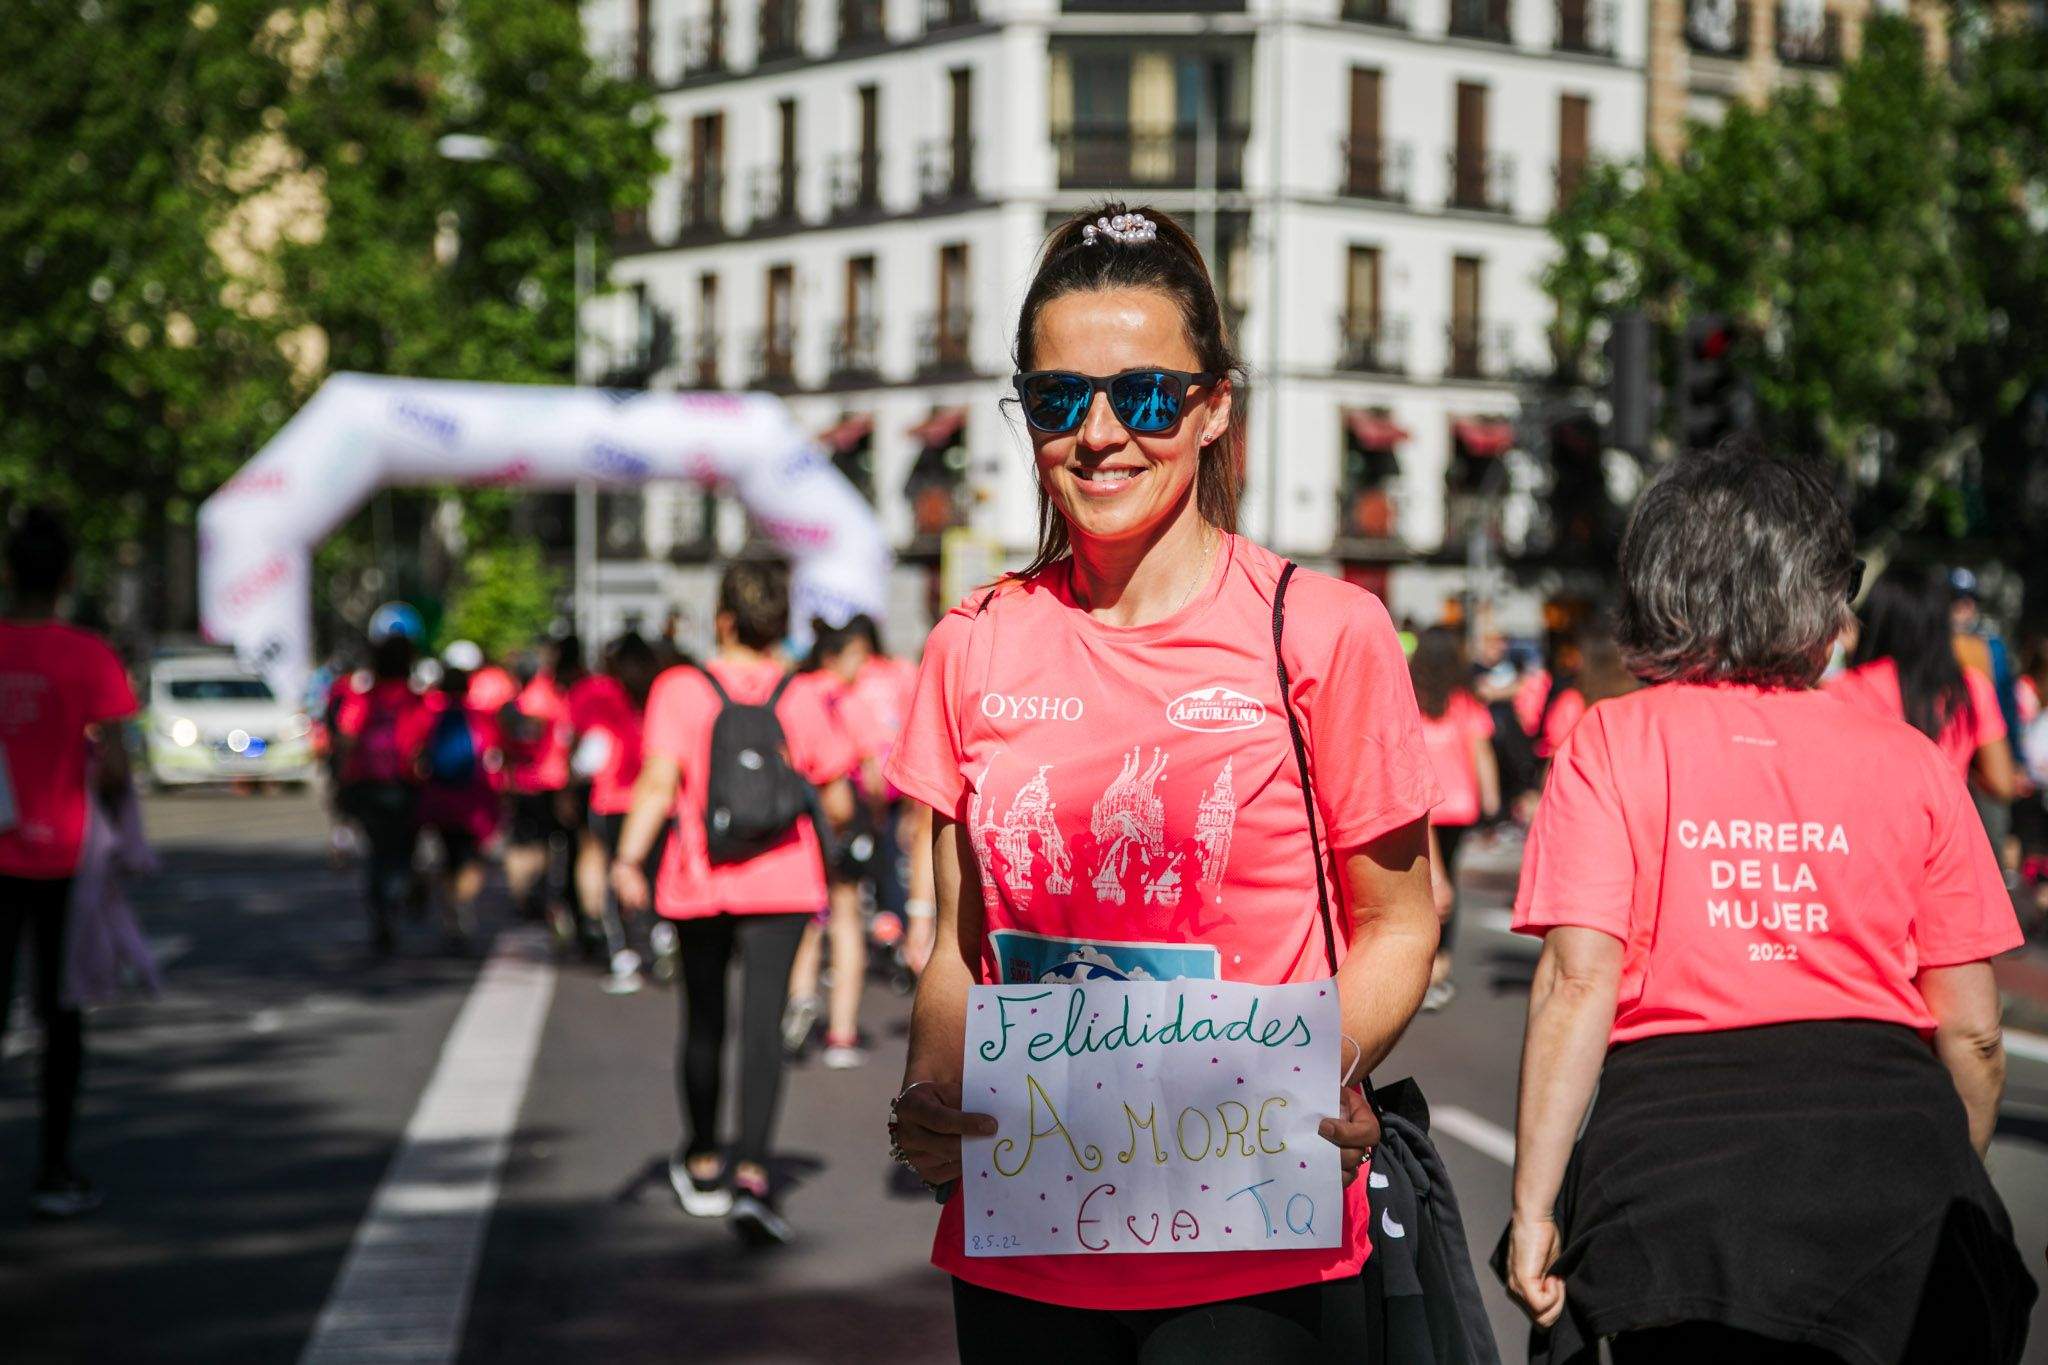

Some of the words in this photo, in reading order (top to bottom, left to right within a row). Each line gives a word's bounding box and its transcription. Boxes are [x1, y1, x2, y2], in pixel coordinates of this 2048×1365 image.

[981, 692, 1084, 721] OYSHO
[1173, 703, 1258, 722] ASTURIANA
[1678, 819, 1849, 855] CARRERA
[1710, 860, 1761, 889] DE
[1772, 863, 1818, 892] LA
[1707, 900, 1829, 932] MUJER
[1748, 943, 1799, 961] 2022
[972, 1235, 1021, 1250] 8.5.22
